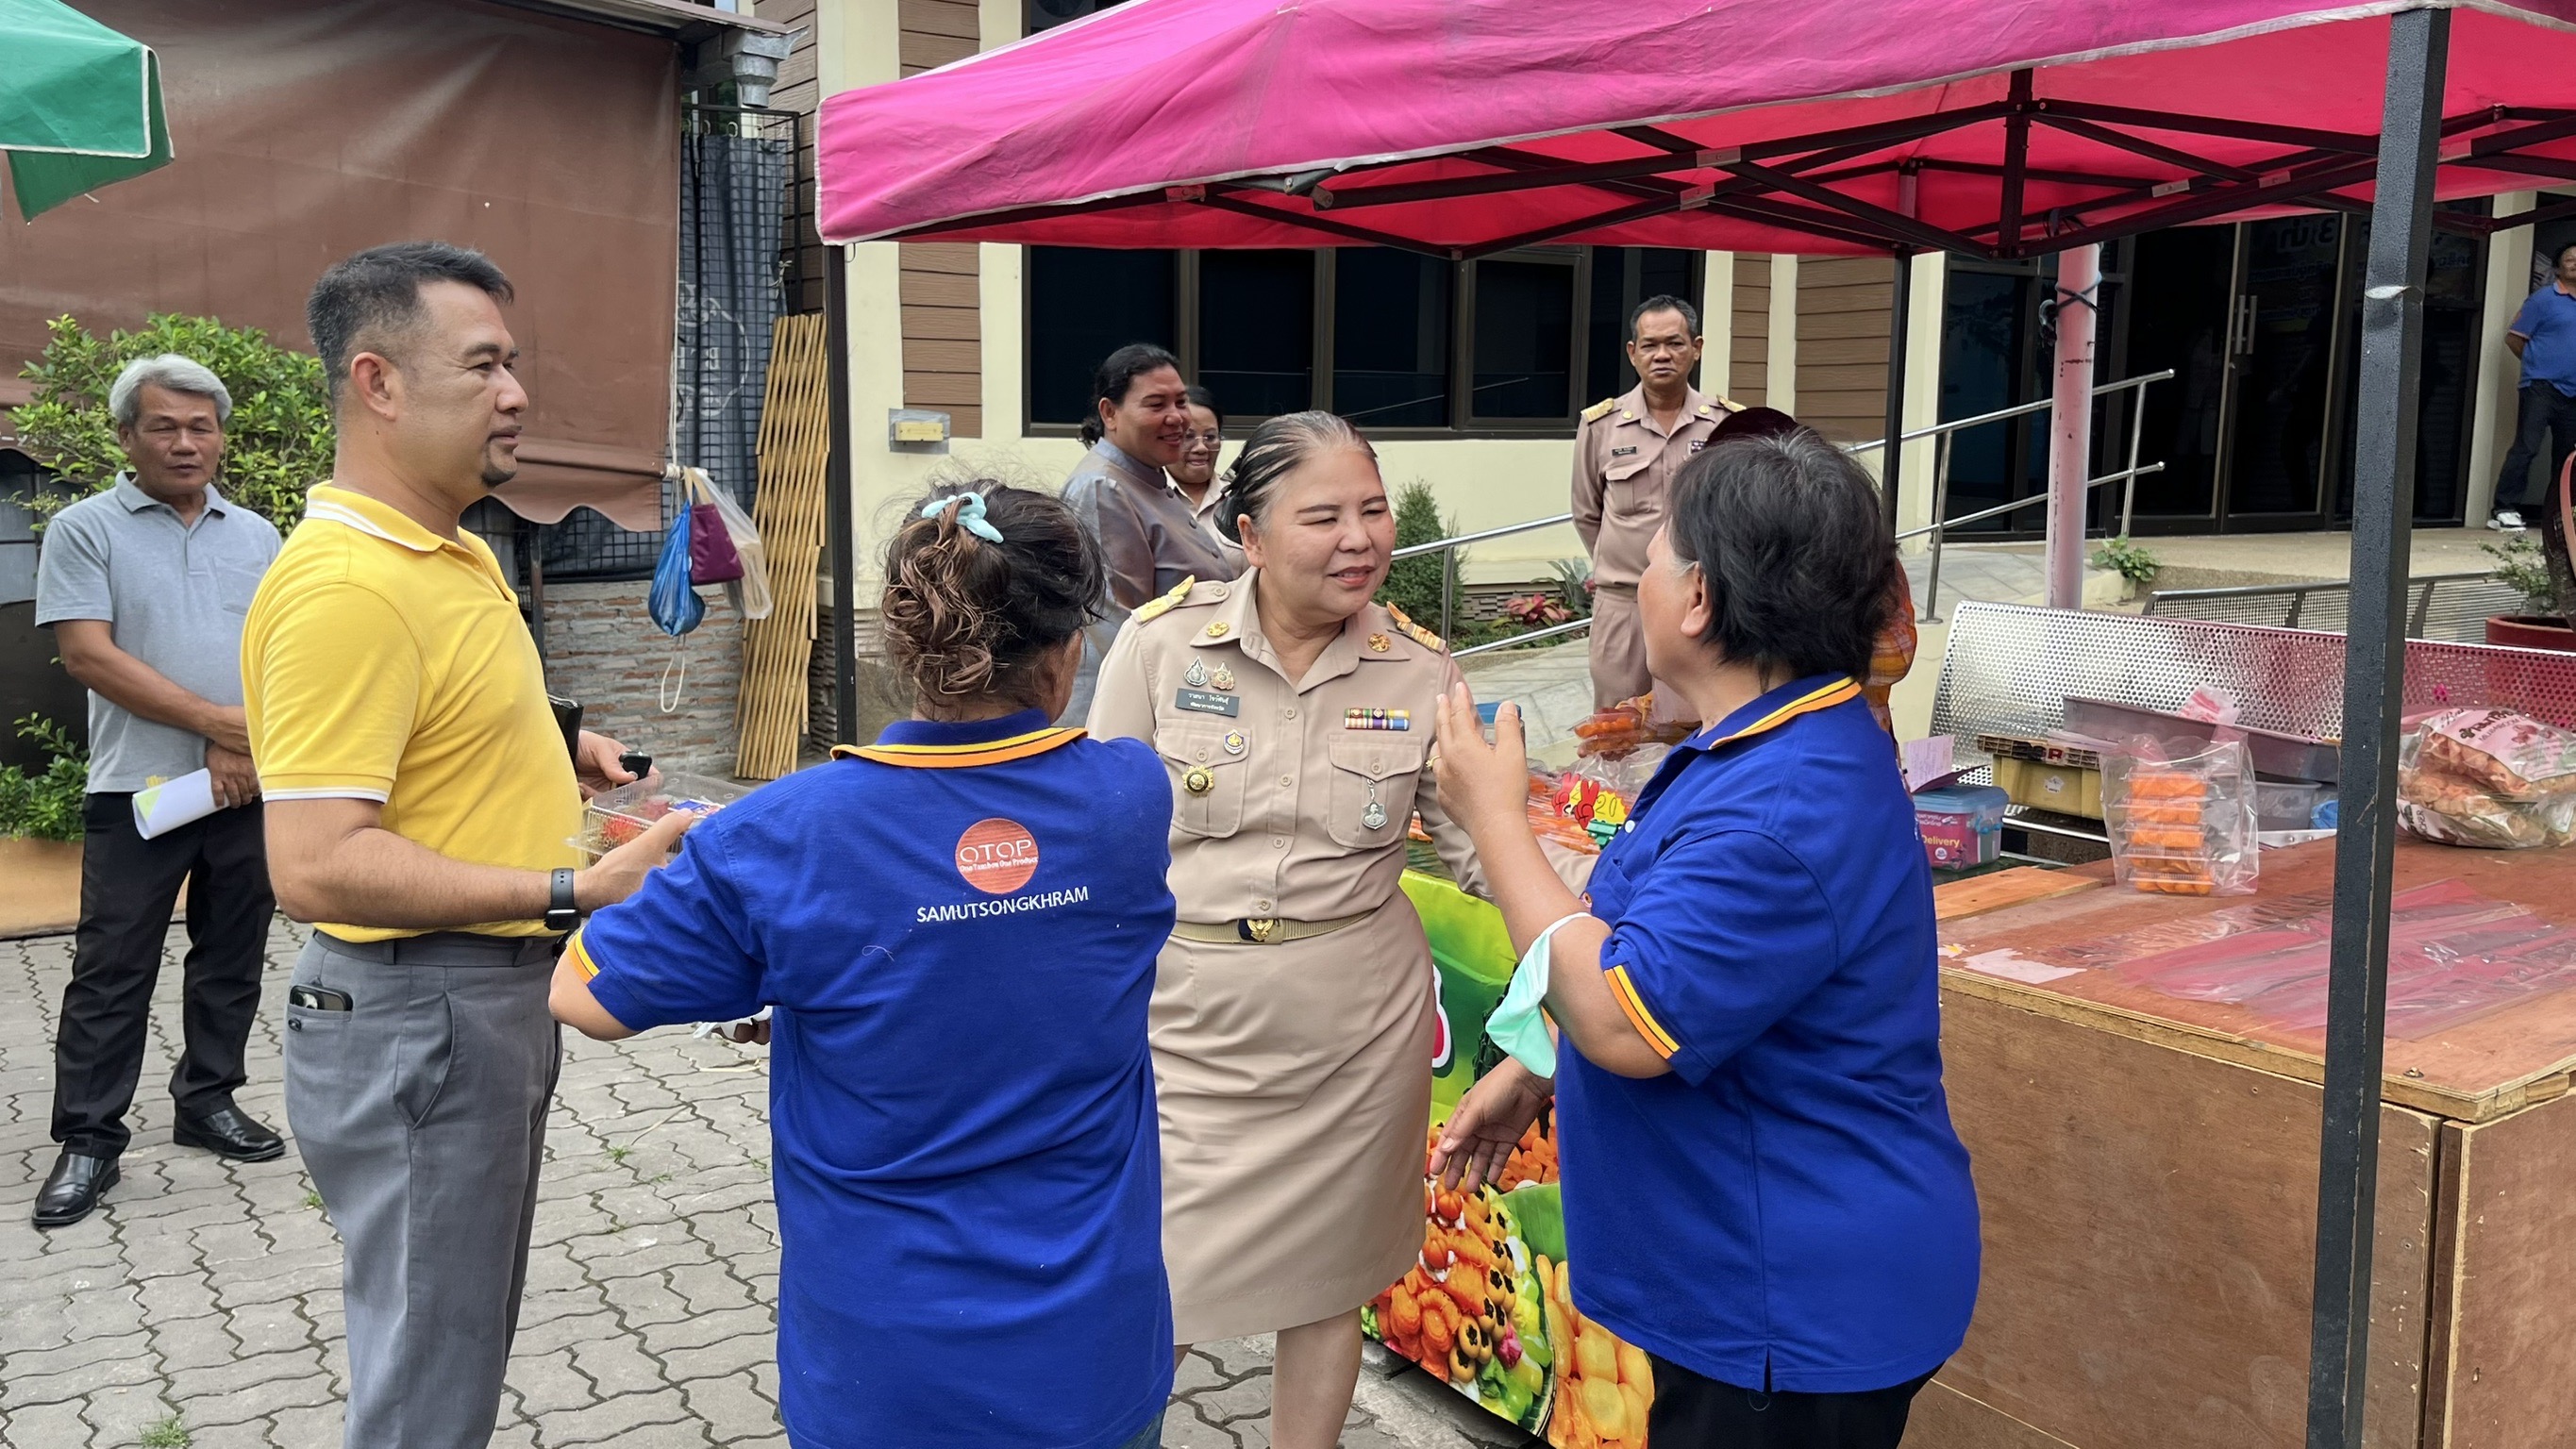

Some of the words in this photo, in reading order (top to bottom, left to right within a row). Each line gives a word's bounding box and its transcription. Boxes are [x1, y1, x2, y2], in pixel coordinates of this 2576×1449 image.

[1595, 793, 1617, 818] 20
[959, 839, 1032, 863] OTOP
[916, 886, 1089, 923] SAMUTSONGKHRAM
